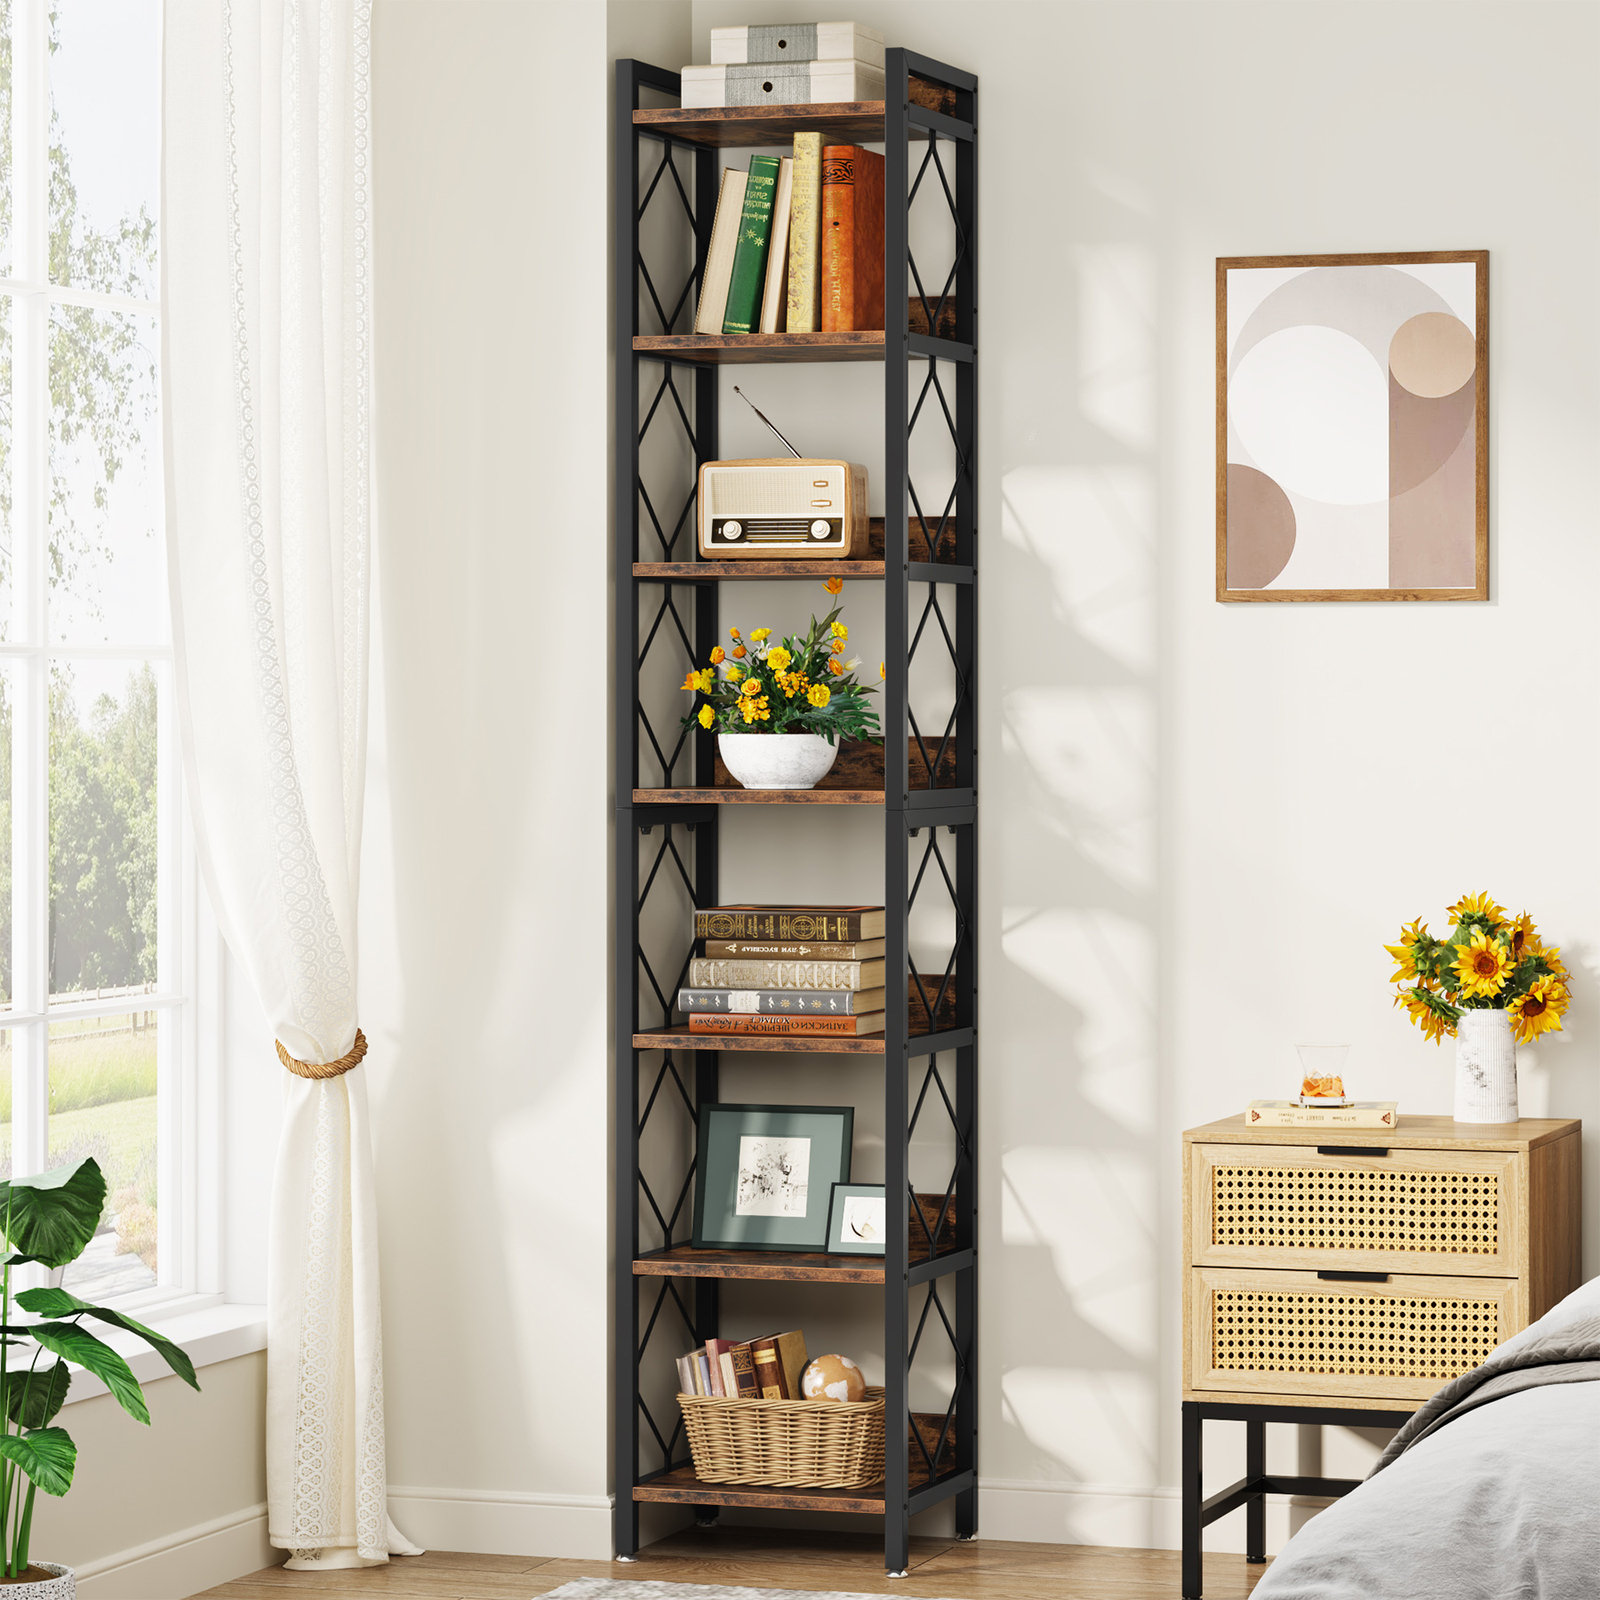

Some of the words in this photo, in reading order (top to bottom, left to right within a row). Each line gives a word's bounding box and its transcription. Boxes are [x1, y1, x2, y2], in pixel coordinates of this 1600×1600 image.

[749, 1015, 791, 1025] ХОЛМСЕ
[743, 1023, 790, 1033] ШЕРЛОКЕ
[791, 1021, 799, 1030] О
[801, 1021, 848, 1031] ЗАПИСКИ
